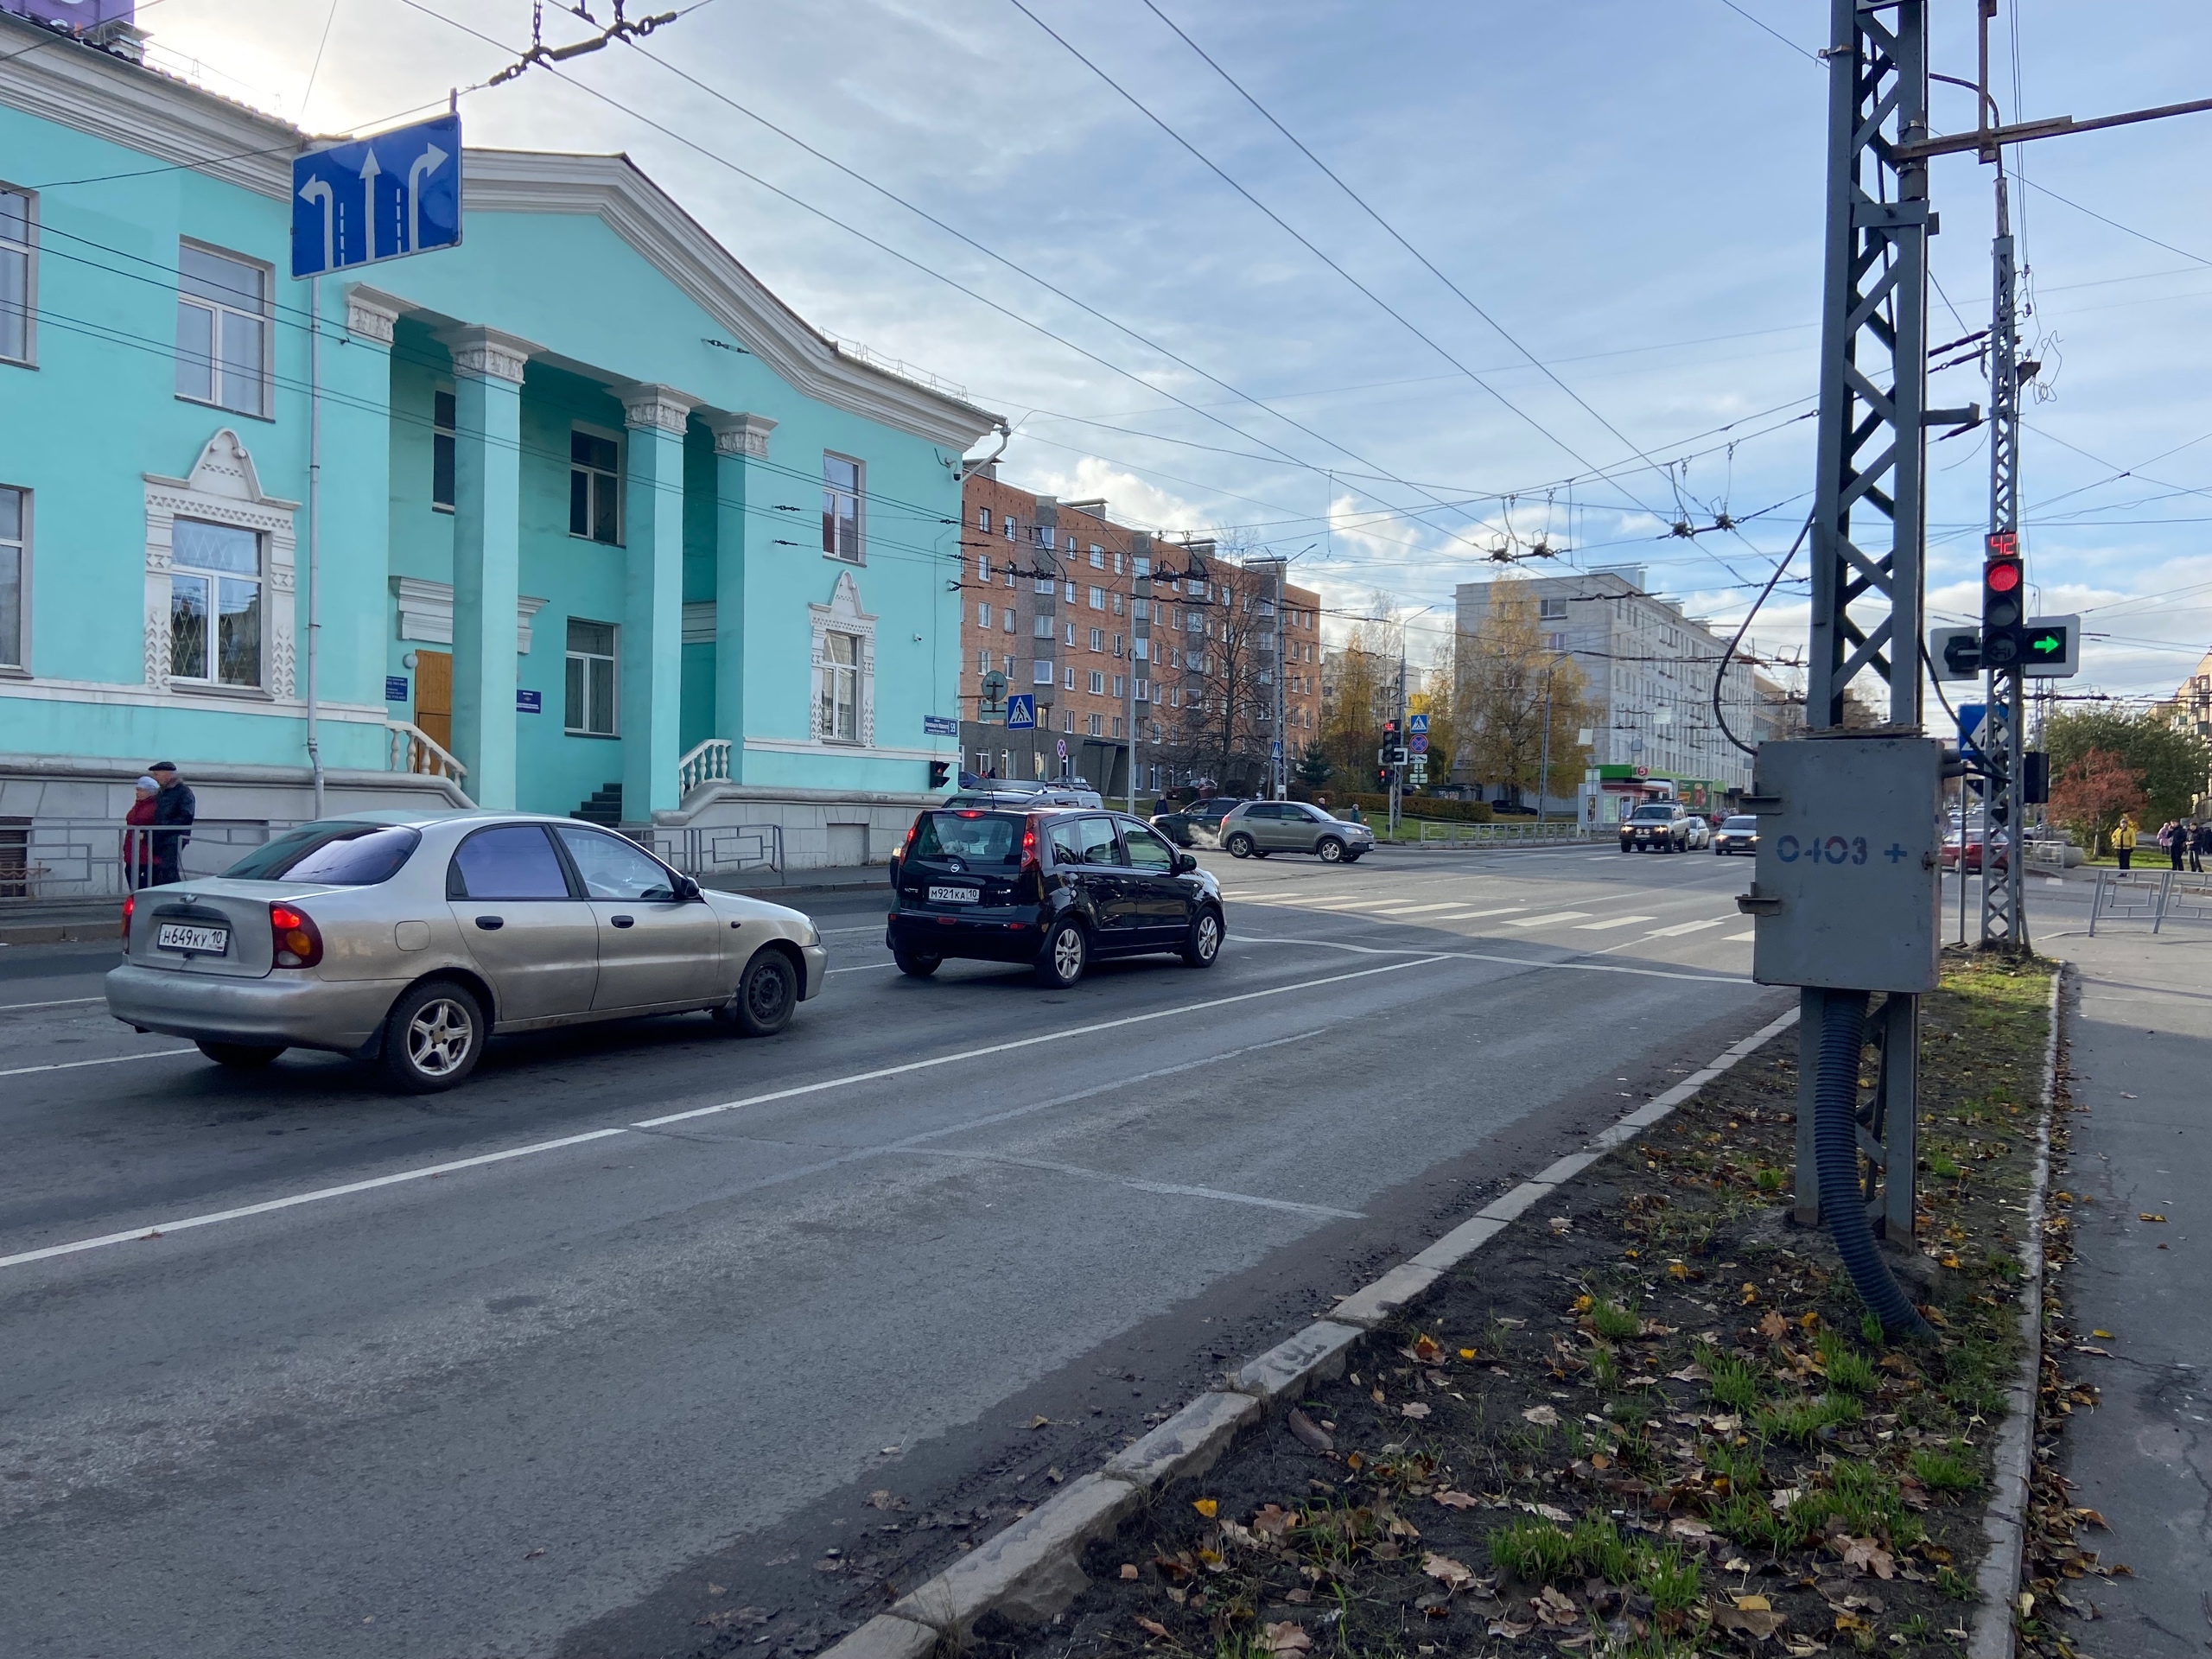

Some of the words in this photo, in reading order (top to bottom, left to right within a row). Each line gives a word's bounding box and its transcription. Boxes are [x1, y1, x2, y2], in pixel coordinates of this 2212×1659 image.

[1990, 533, 2016, 555] 42
[968, 889, 977, 898] 10
[212, 931, 223, 944] 10
